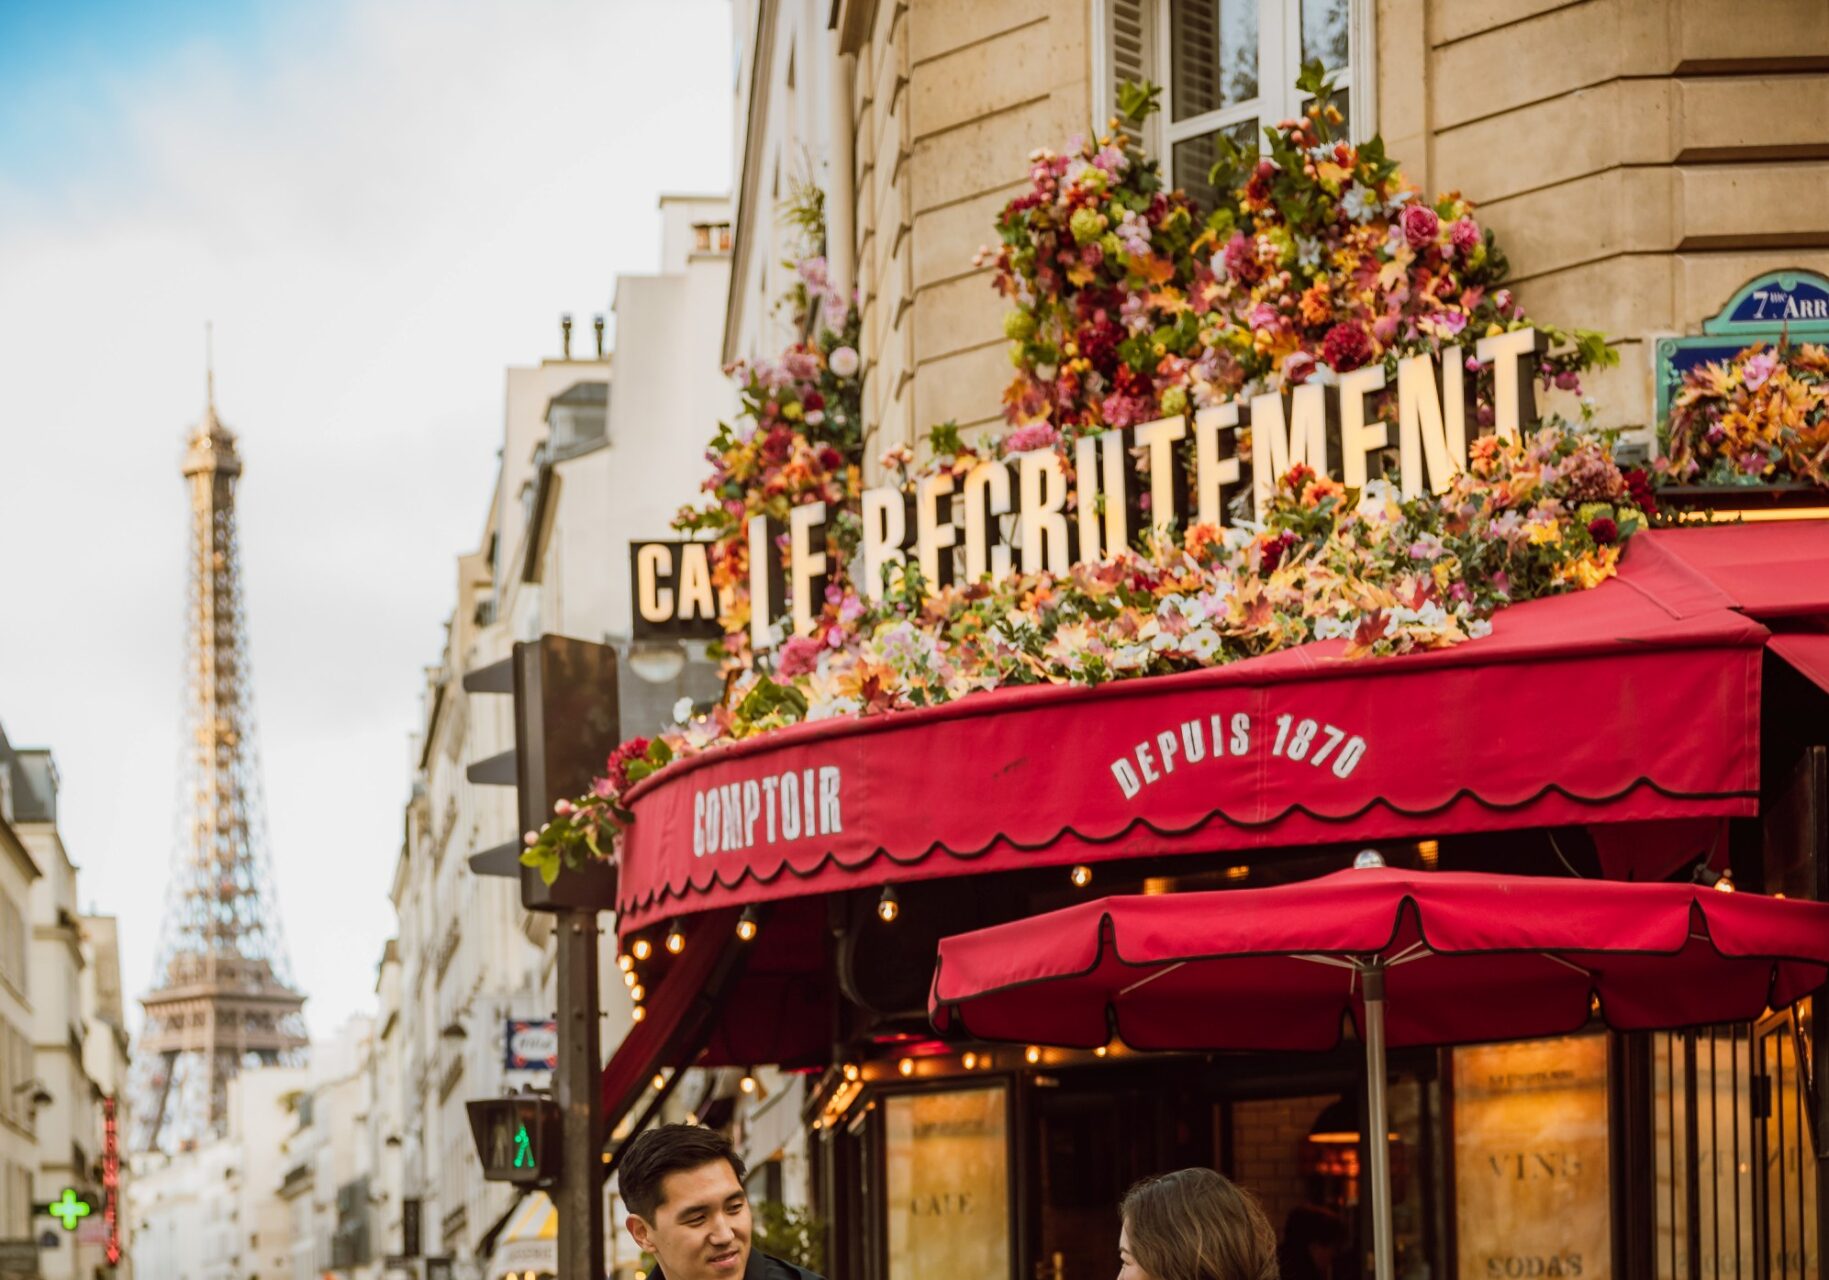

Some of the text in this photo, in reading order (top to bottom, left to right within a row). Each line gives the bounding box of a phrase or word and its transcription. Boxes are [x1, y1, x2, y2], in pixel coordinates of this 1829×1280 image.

[637, 543, 733, 623] CA
[1110, 713, 1367, 800] DEPUIS 1870
[692, 765, 843, 858] COMPTOIR
[1486, 1253, 1583, 1280] SODAS
